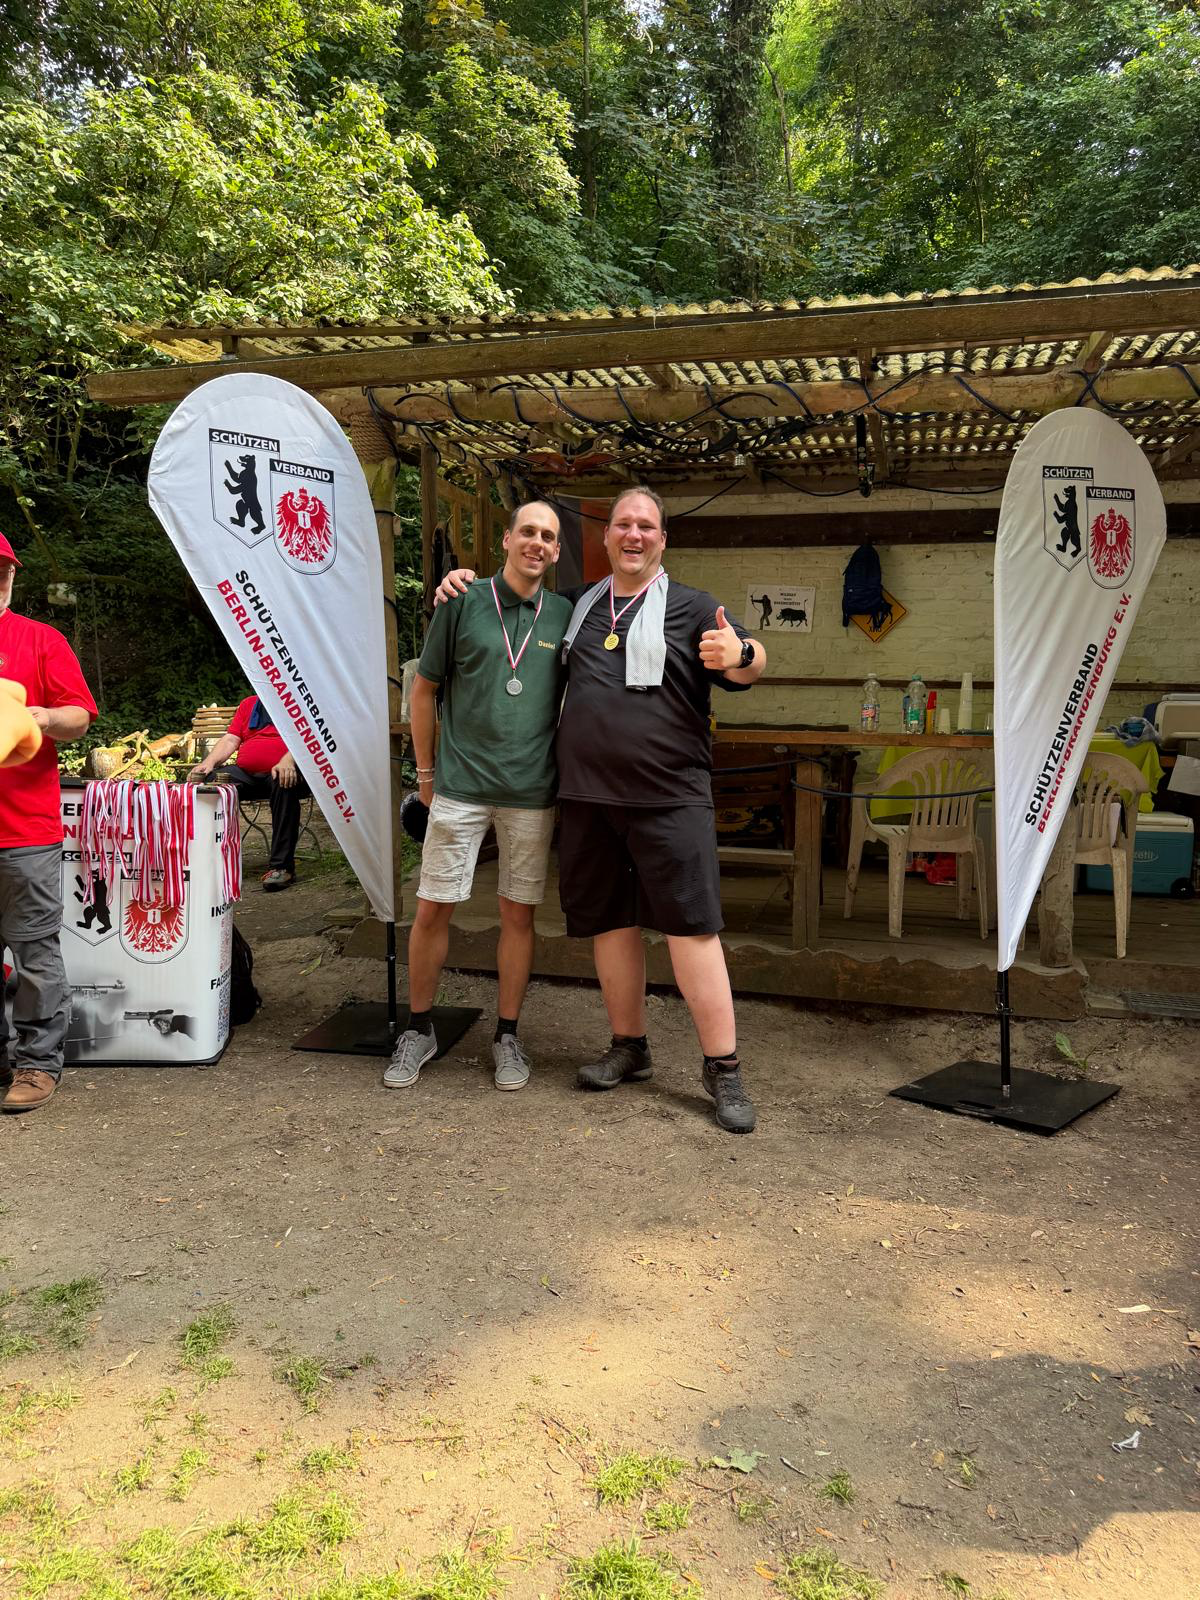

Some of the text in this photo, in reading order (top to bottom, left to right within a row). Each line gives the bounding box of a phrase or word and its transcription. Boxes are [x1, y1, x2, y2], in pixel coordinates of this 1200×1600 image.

[211, 431, 278, 452] SCHÜTZEN
[273, 461, 331, 482] VERBAND
[1043, 467, 1092, 479] SCHÜTZEN
[1089, 488, 1132, 499] VERBAND
[538, 640, 556, 650] Daniel
[235, 569, 337, 754] SCHÜTZENVERBAND
[216, 578, 339, 789] BERLIN-BRANDENBURG
[1025, 643, 1098, 826] SCHÜTZENVERBAND
